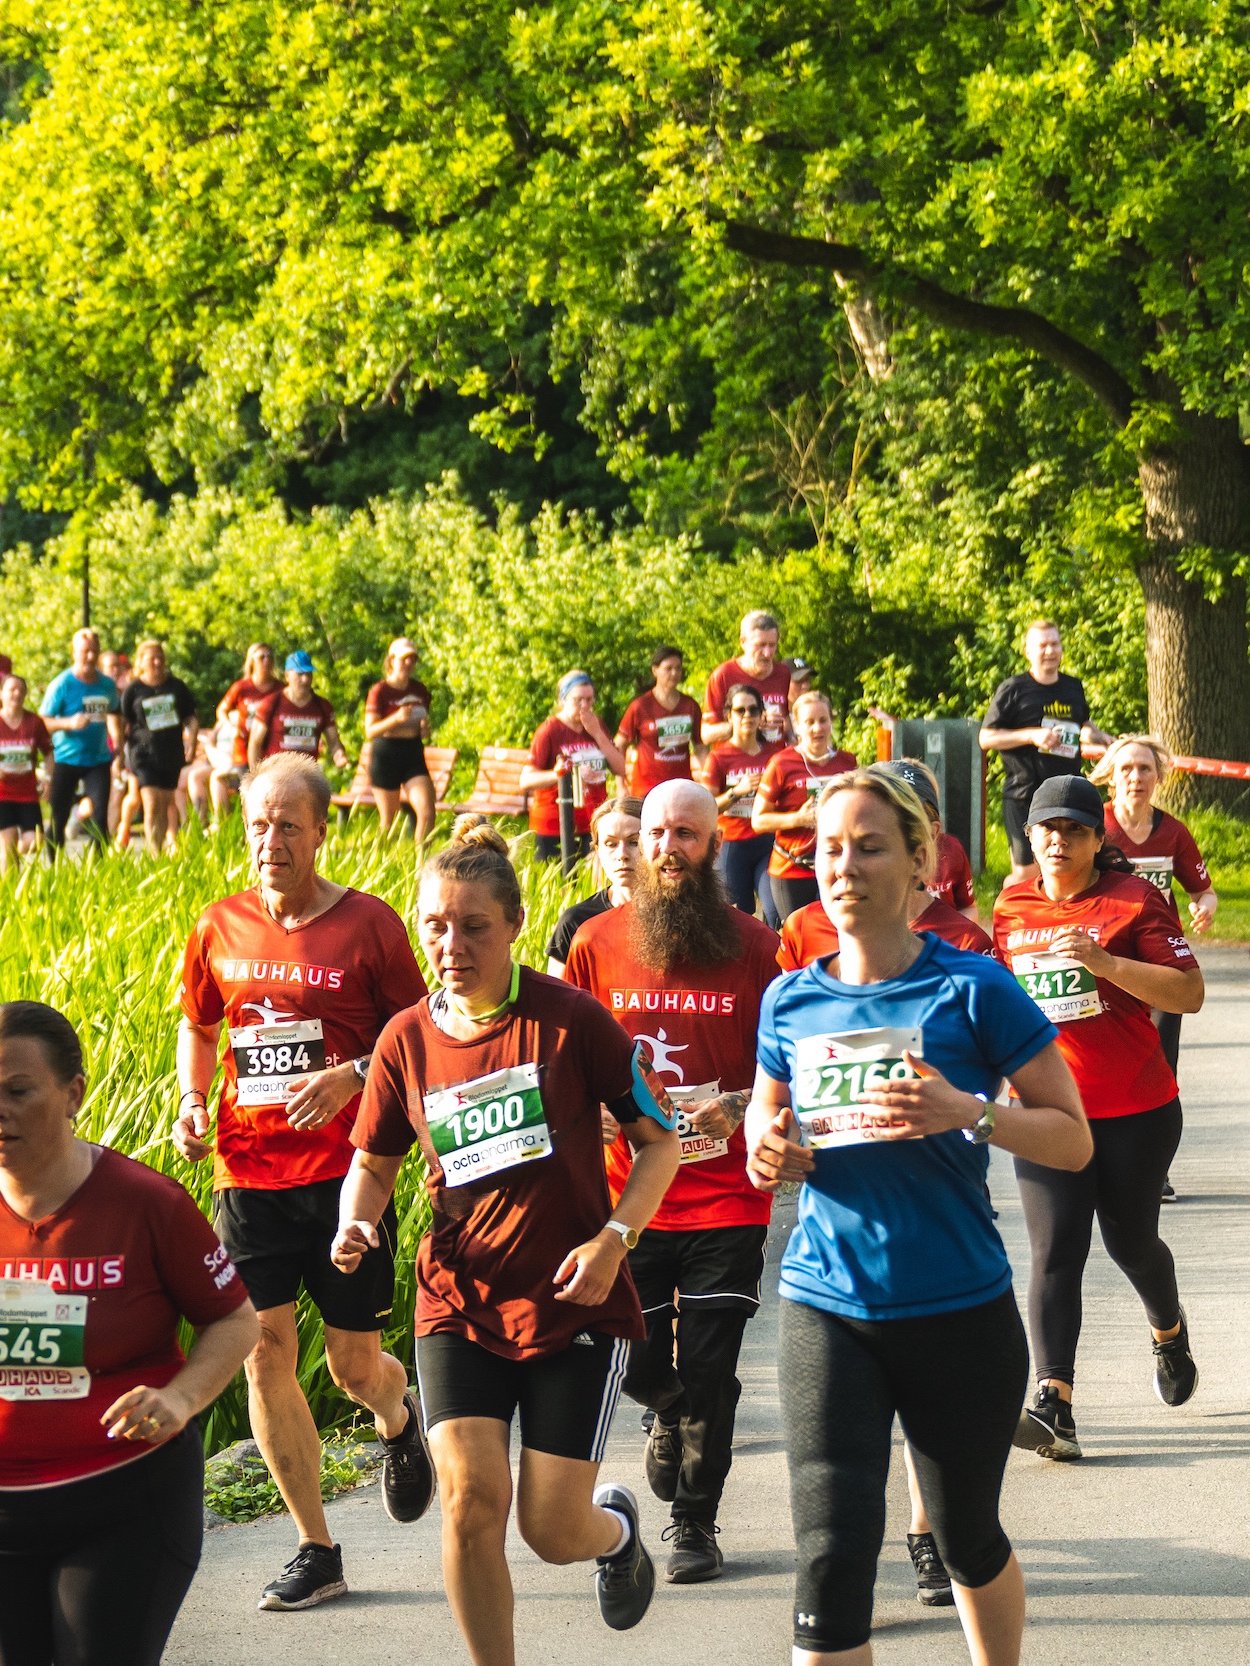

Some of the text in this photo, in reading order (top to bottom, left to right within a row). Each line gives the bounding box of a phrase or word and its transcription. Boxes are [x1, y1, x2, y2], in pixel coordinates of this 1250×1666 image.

[289, 726, 313, 737] 4018
[224, 963, 342, 989] BAUHAUS
[1025, 969, 1082, 998] 3412
[612, 991, 733, 1013] BAUHAUS
[246, 1044, 311, 1075] 3984
[446, 1095, 524, 1147] 1900
[452, 1134, 536, 1170] octapharma
[24, 1386, 42, 1396] ICA
